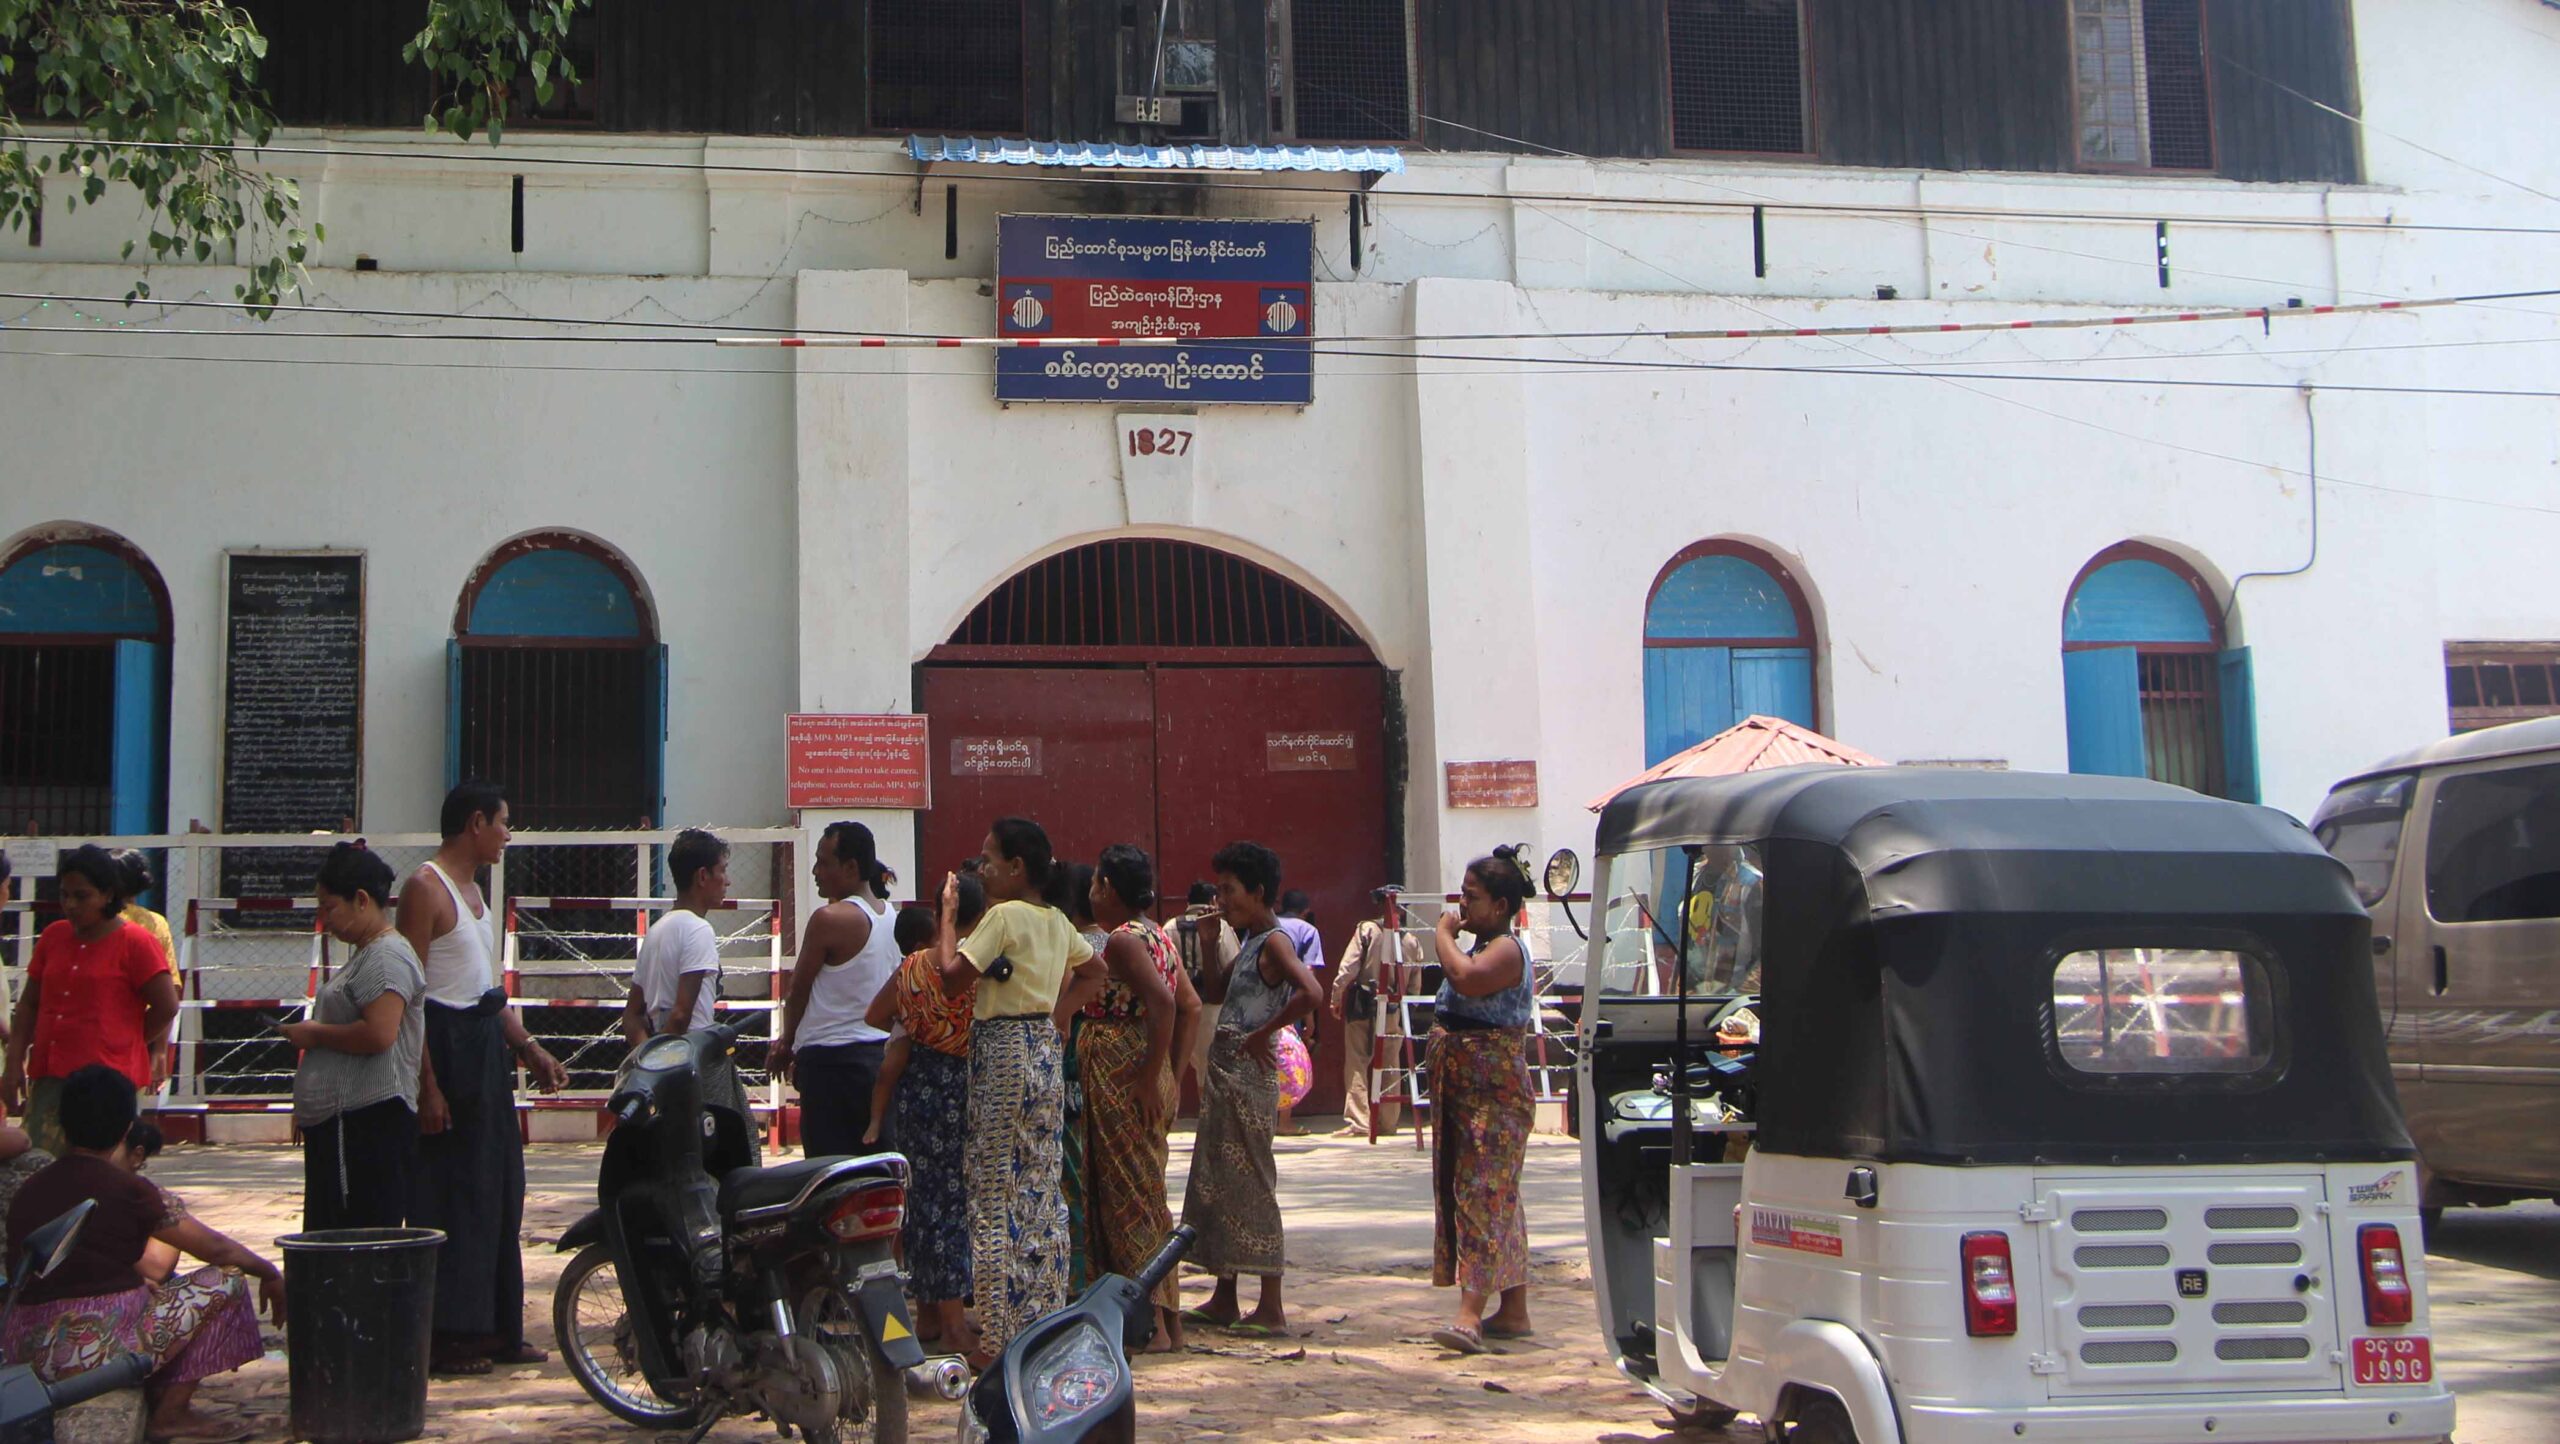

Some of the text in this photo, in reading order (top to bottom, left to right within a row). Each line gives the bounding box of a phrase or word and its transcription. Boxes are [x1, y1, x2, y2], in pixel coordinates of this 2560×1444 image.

[1045, 350, 1264, 389] စစ်တွေအကျဉ်းထောင်
[1129, 428, 1193, 456] 1827
[798, 766, 810, 775] No
[834, 766, 863, 775] allowed
[864, 767, 873, 775] to
[873, 766, 889, 775] take
[2348, 1183, 2379, 1193] TWIN
[2182, 1278, 2203, 1291] RE
